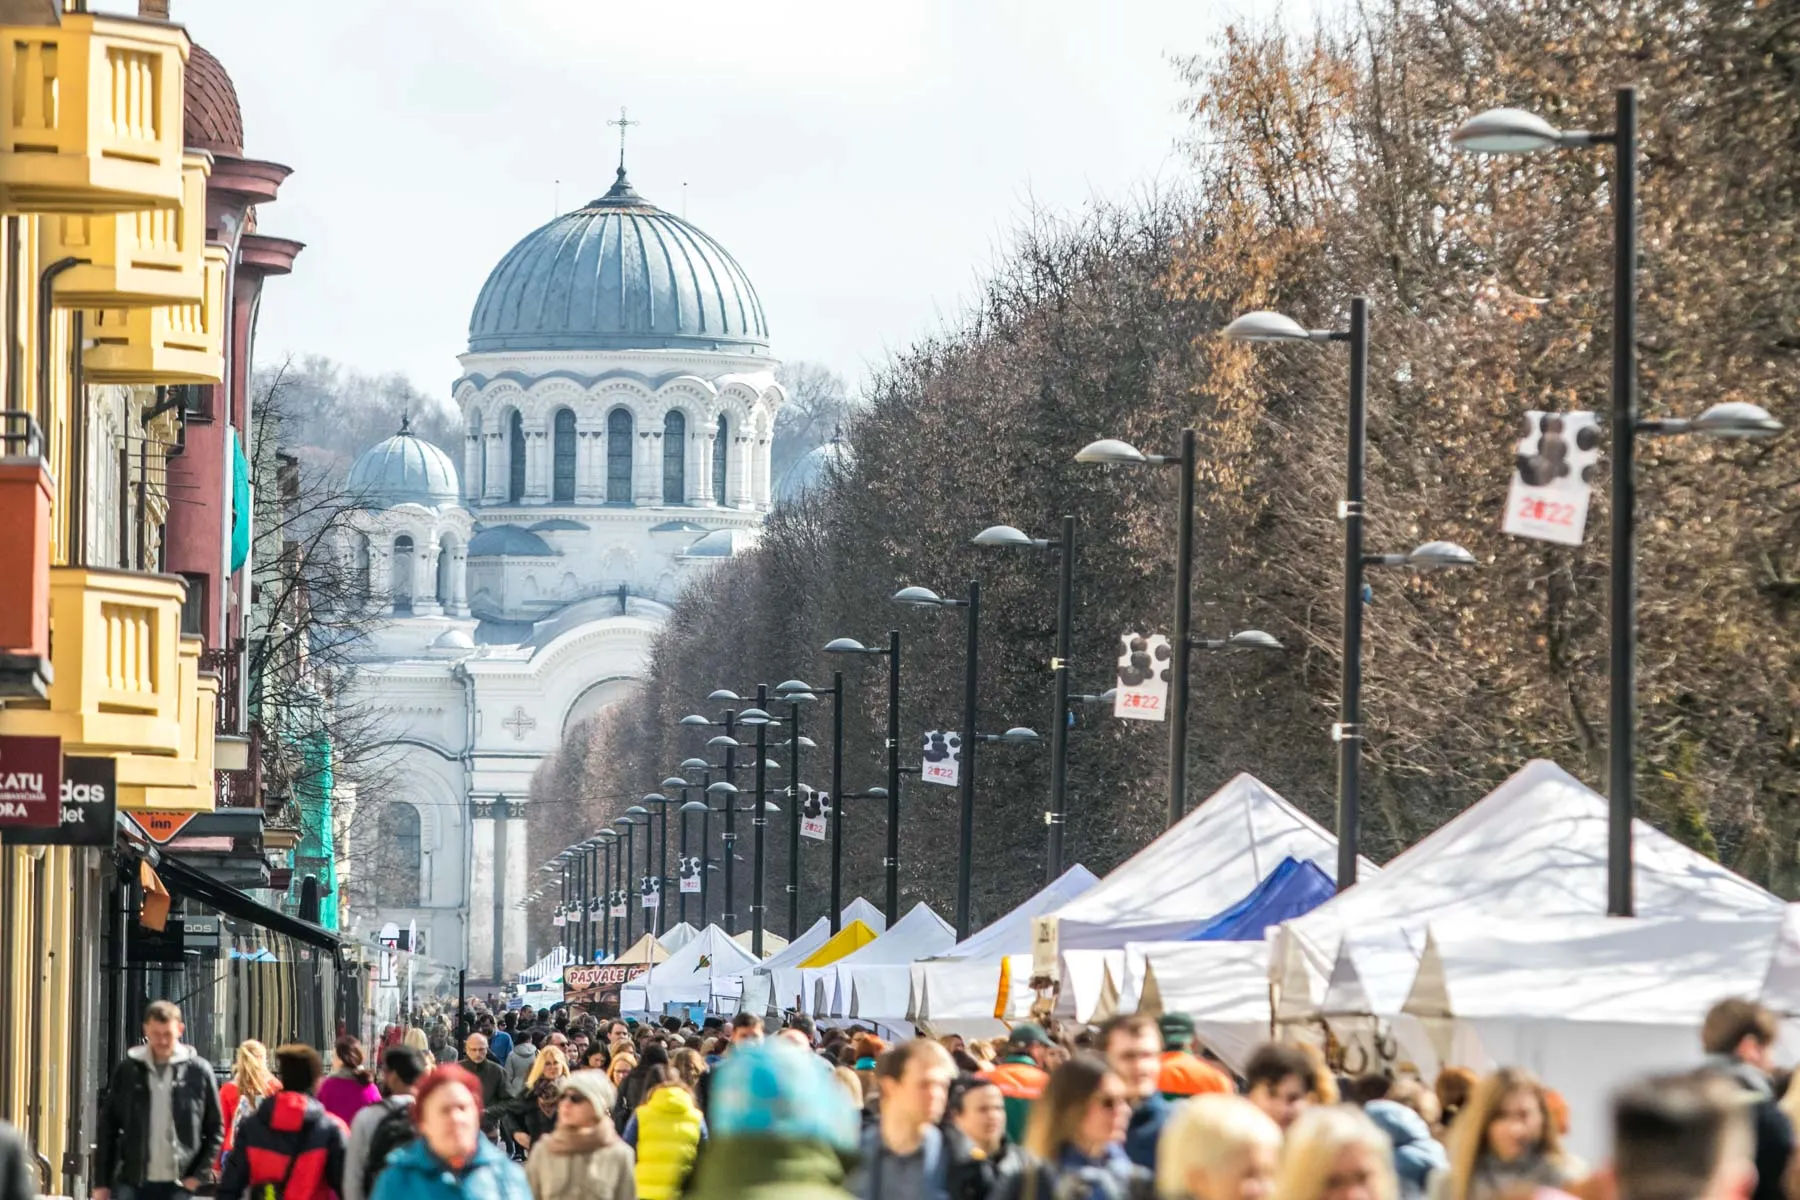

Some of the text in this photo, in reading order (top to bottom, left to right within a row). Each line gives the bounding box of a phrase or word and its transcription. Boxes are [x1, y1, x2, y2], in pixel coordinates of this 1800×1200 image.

[1518, 496, 1577, 526] 2022
[1123, 693, 1160, 710] 2022
[927, 765, 954, 779] 2022
[150, 816, 172, 829] inn
[804, 821, 824, 834] 2022
[570, 970, 625, 984] PASVALE
